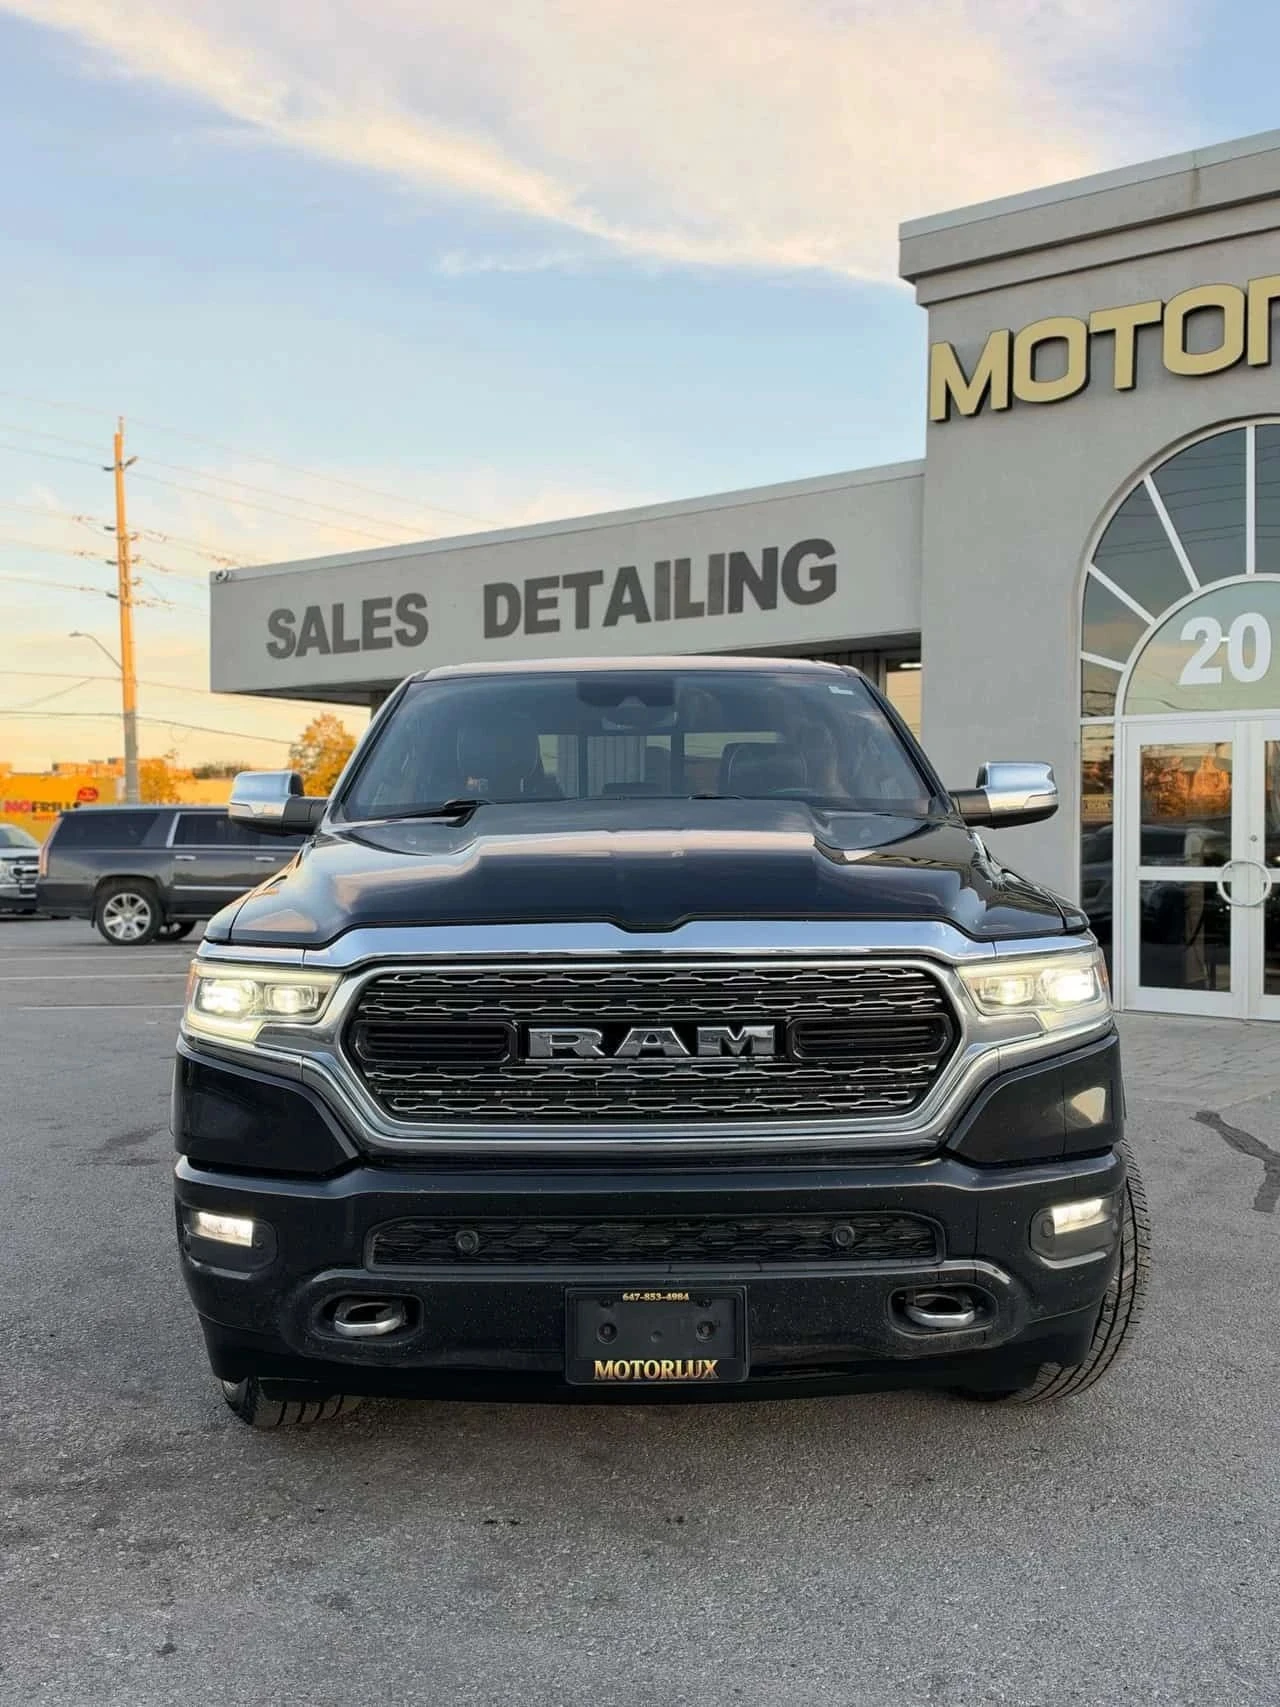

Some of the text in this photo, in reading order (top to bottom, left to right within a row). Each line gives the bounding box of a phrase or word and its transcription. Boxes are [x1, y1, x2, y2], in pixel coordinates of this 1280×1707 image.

[266, 538, 837, 659] SALES DETAILING
[1178, 612, 1271, 686] 20
[528, 1025, 776, 1057] RAM
[622, 1291, 690, 1302] 647-853-4984
[594, 1359, 720, 1380] MOTORLUX
